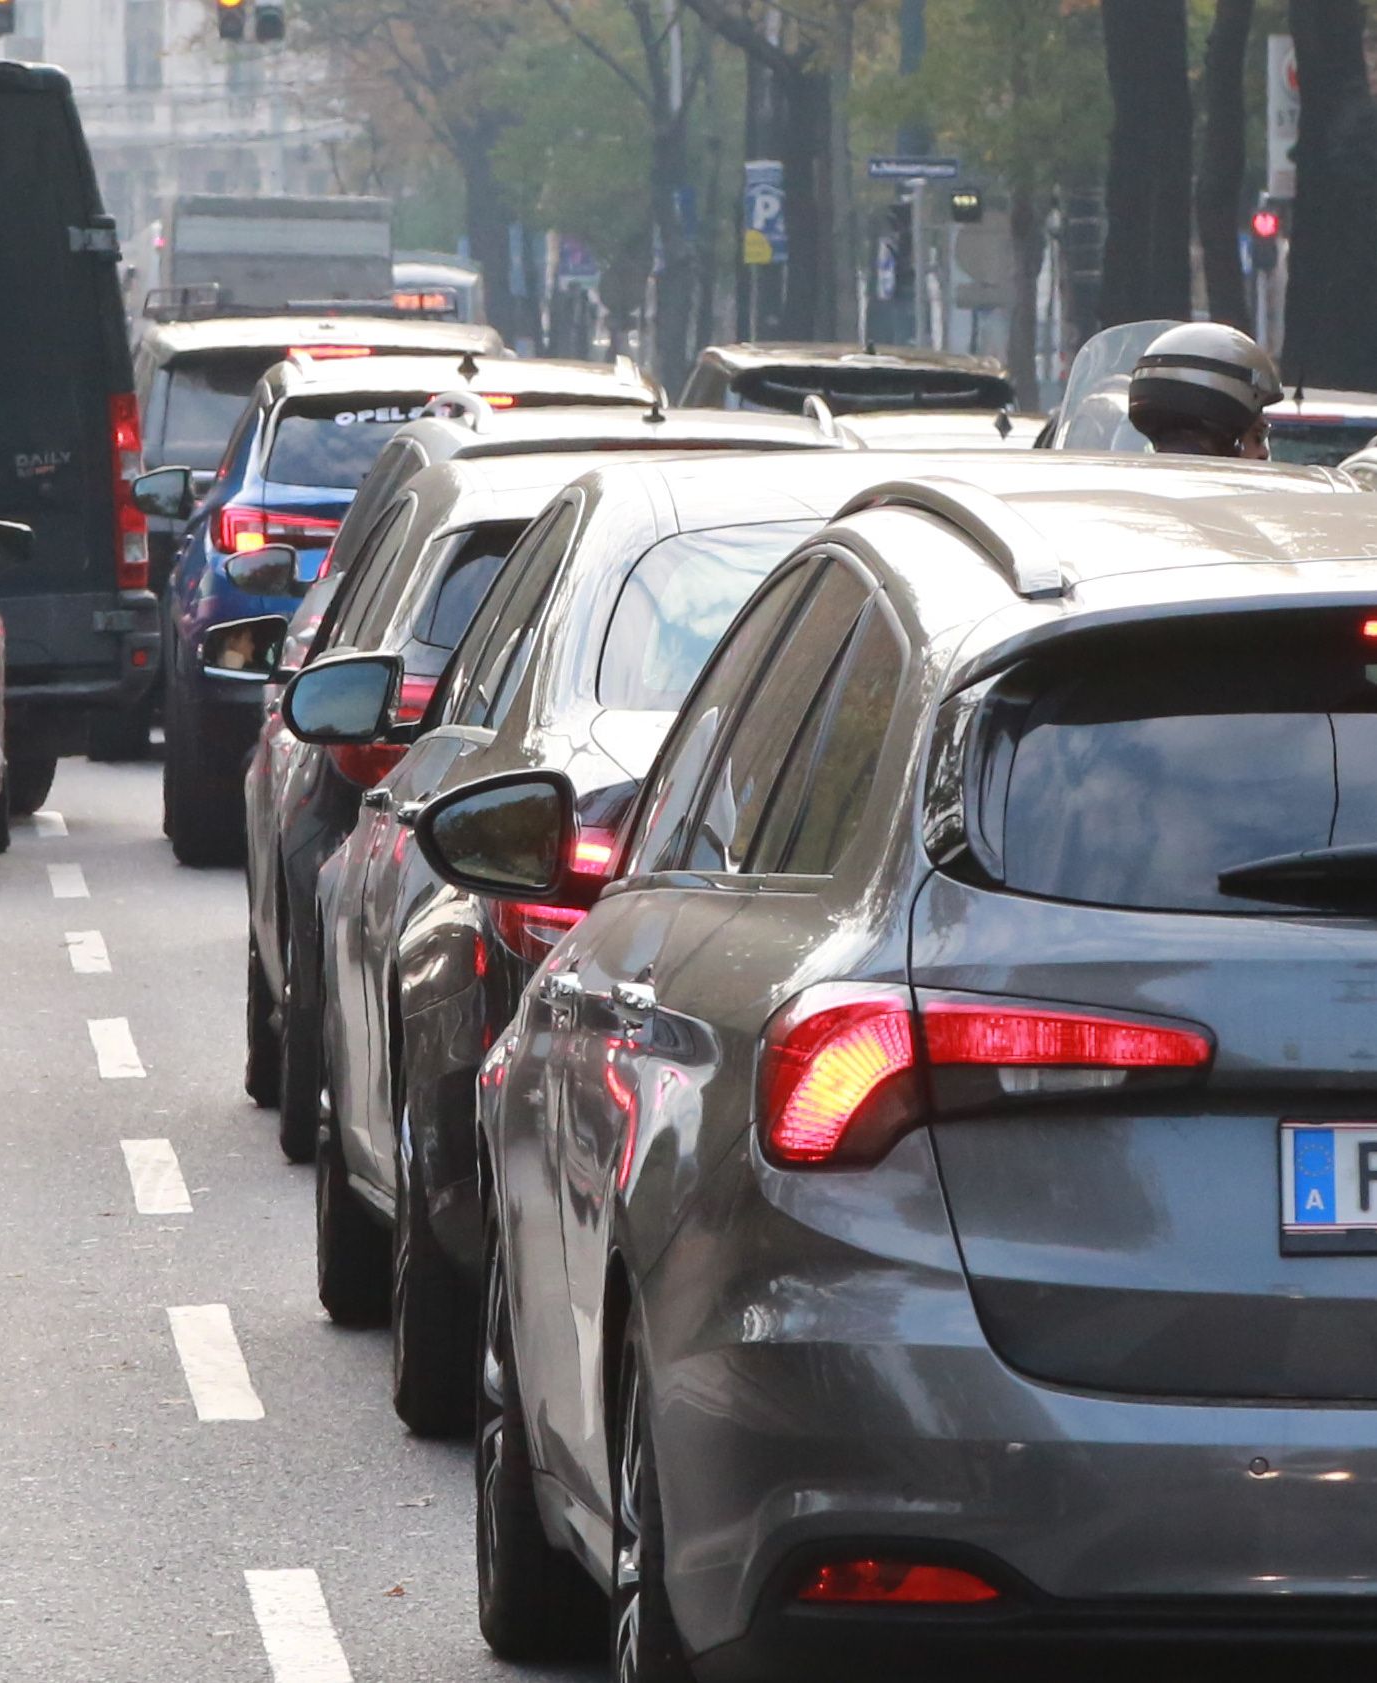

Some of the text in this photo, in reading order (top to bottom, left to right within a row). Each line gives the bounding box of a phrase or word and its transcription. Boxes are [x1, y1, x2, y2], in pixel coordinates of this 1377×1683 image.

[752, 194, 781, 231] P
[334, 406, 406, 427] OPEL
[15, 451, 71, 466] DAILY
[1305, 1188, 1325, 1210] A
